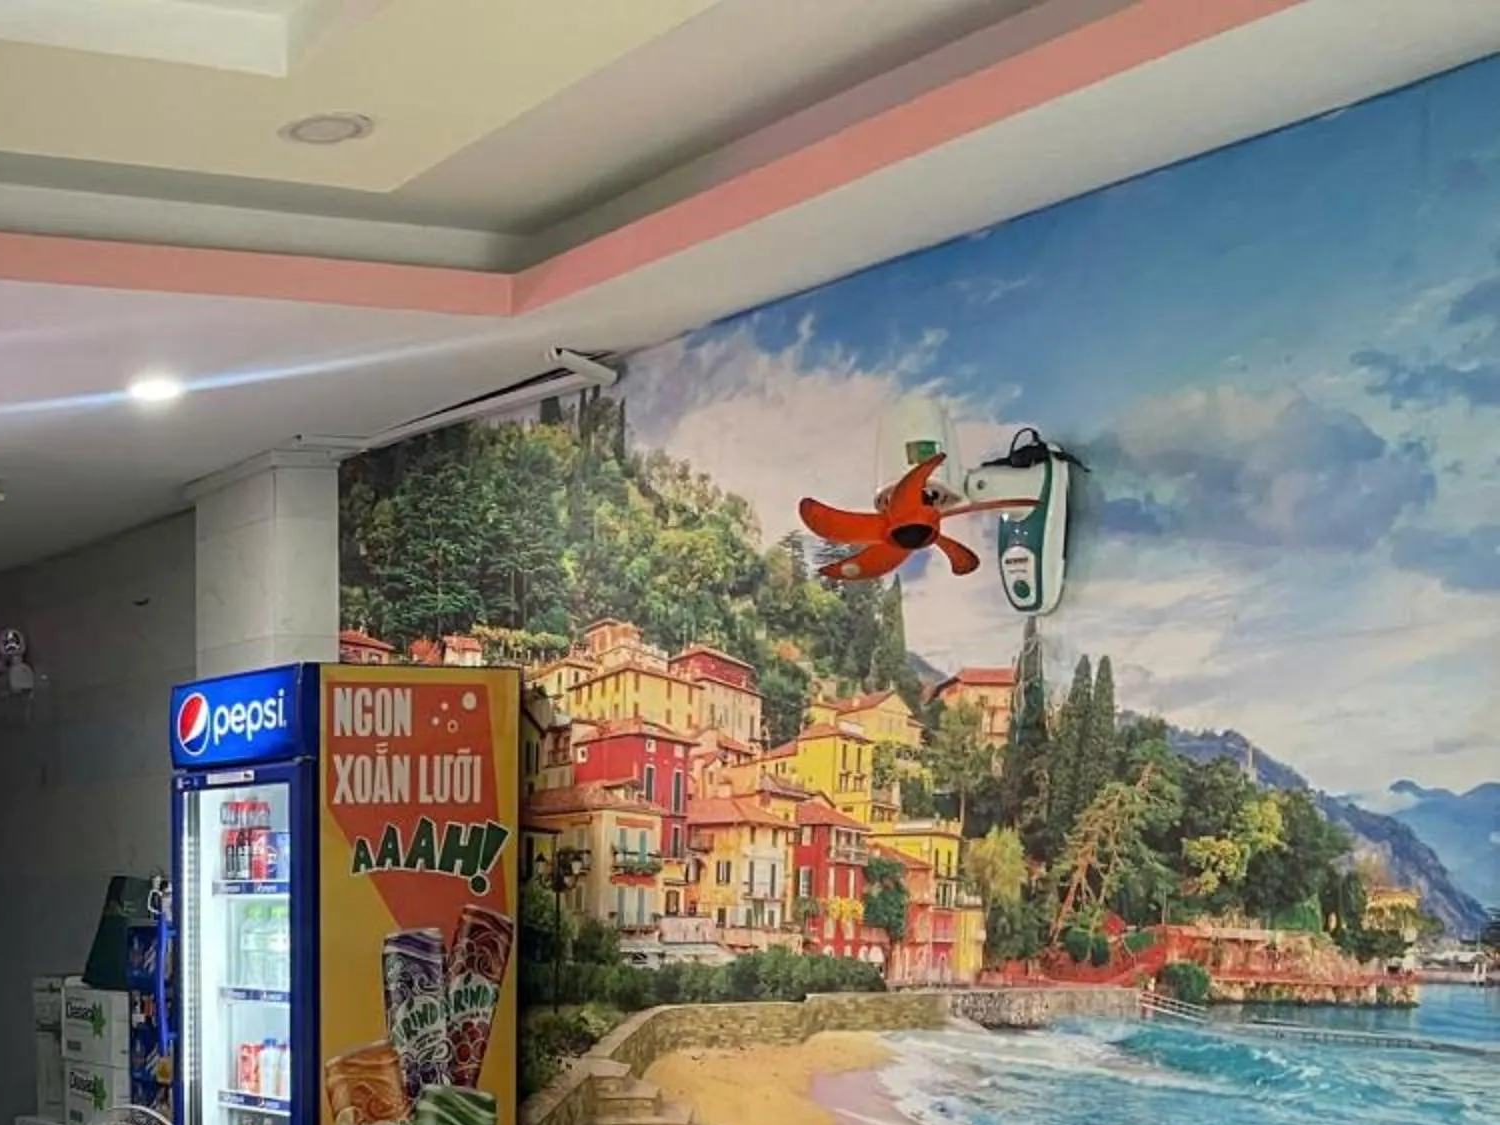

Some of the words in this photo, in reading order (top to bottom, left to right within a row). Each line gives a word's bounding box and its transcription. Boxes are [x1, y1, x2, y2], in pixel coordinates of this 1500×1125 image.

[213, 688, 287, 745] pepsi
[333, 687, 413, 737] NGON
[351, 815, 509, 896] AAAH!
